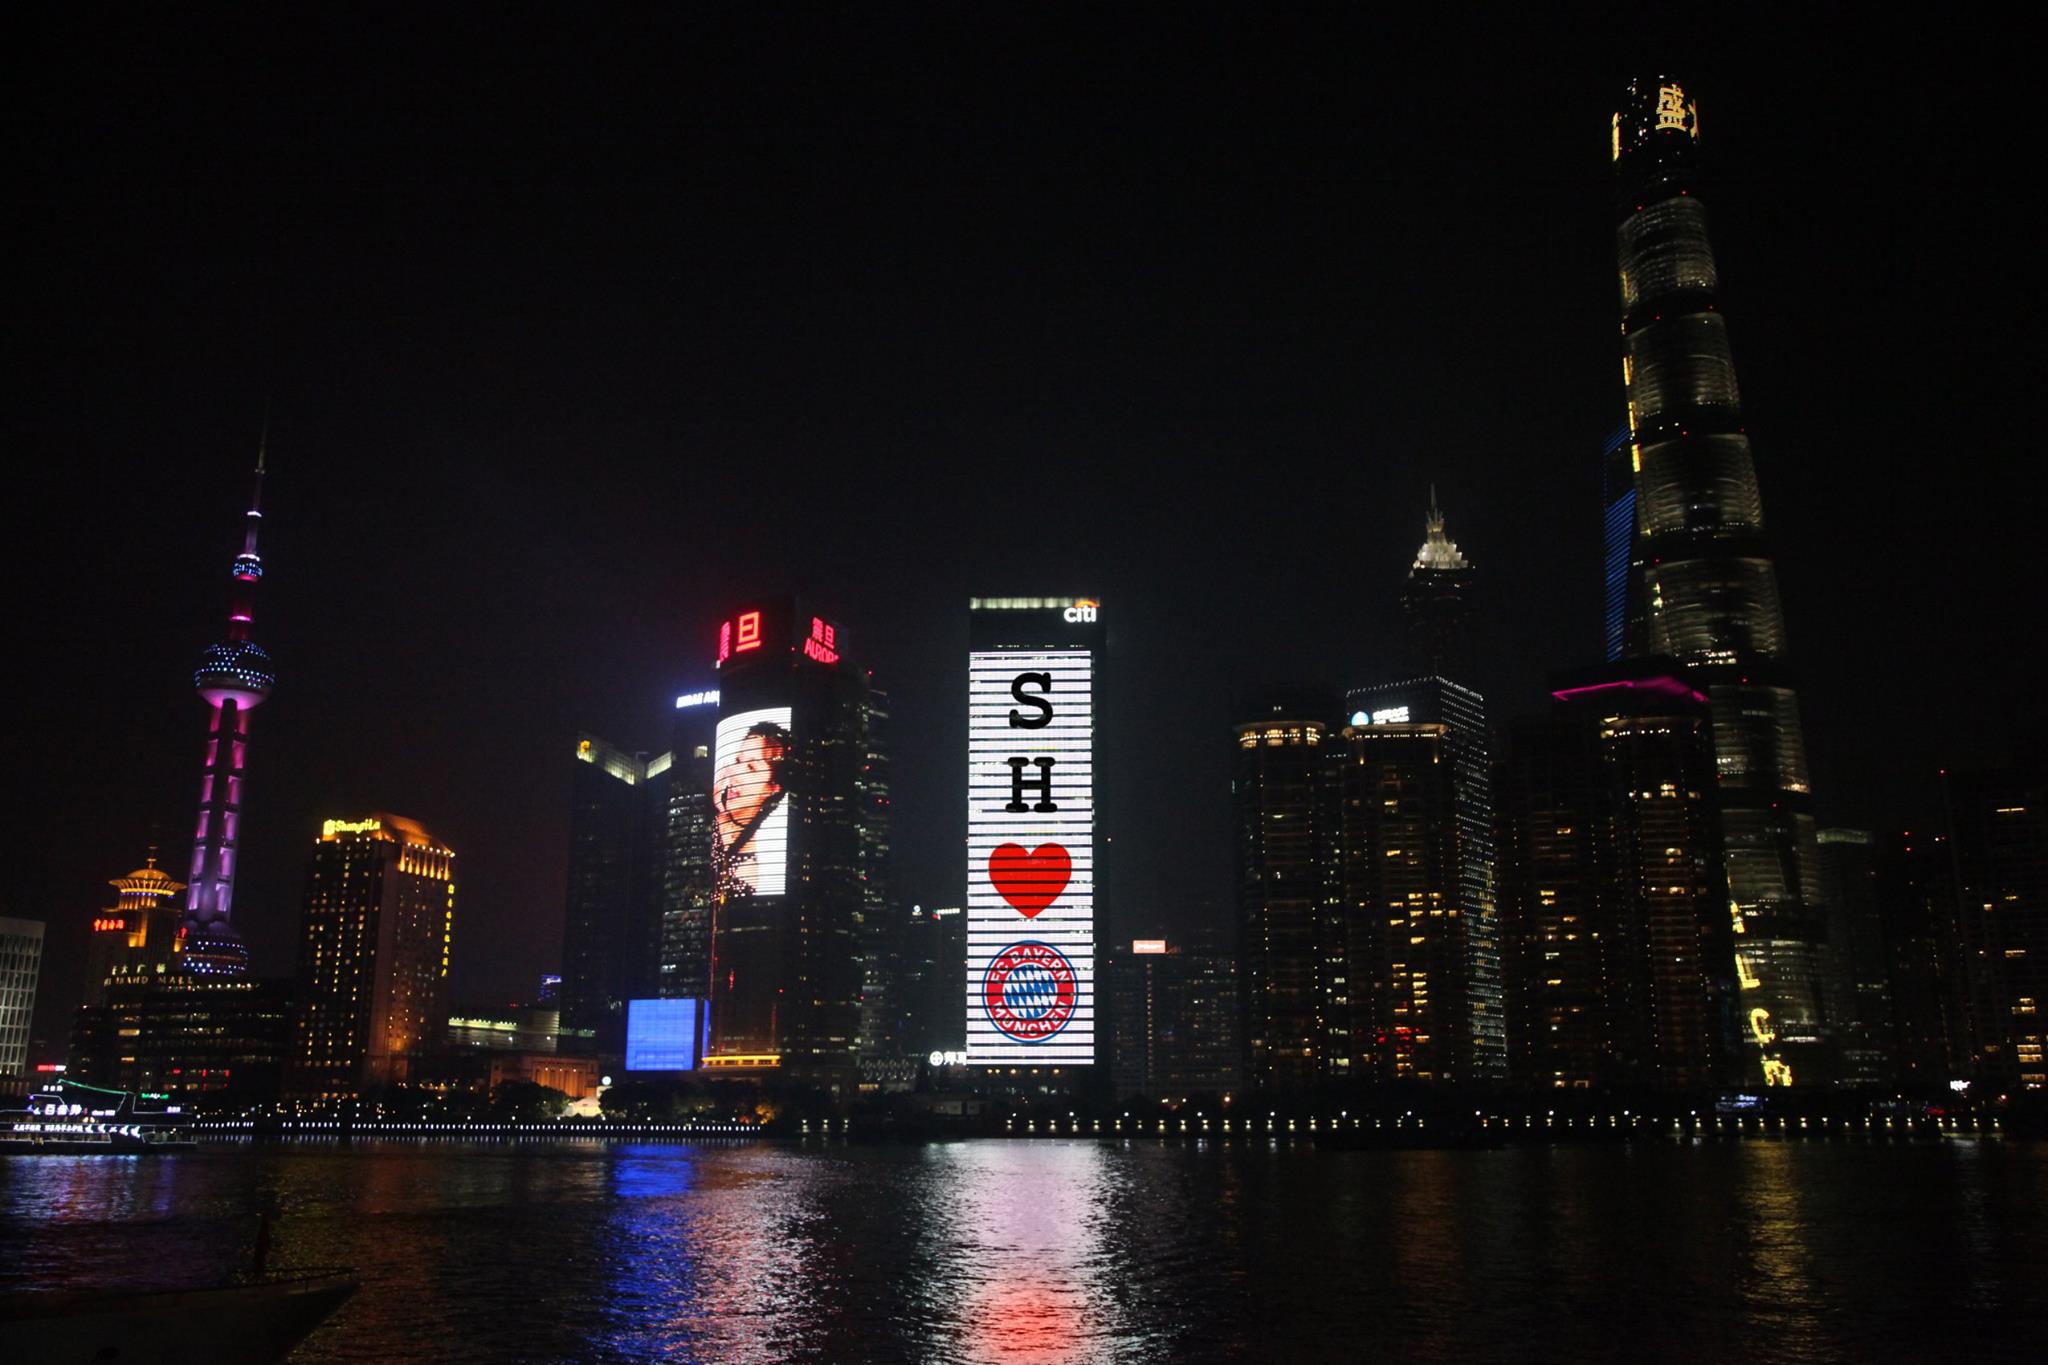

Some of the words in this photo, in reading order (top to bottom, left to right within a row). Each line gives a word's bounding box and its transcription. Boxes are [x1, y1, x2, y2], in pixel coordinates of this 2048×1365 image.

[1063, 604, 1097, 623] citi
[991, 962, 1009, 984] FC
[1009, 947, 1070, 983] BAYERN
